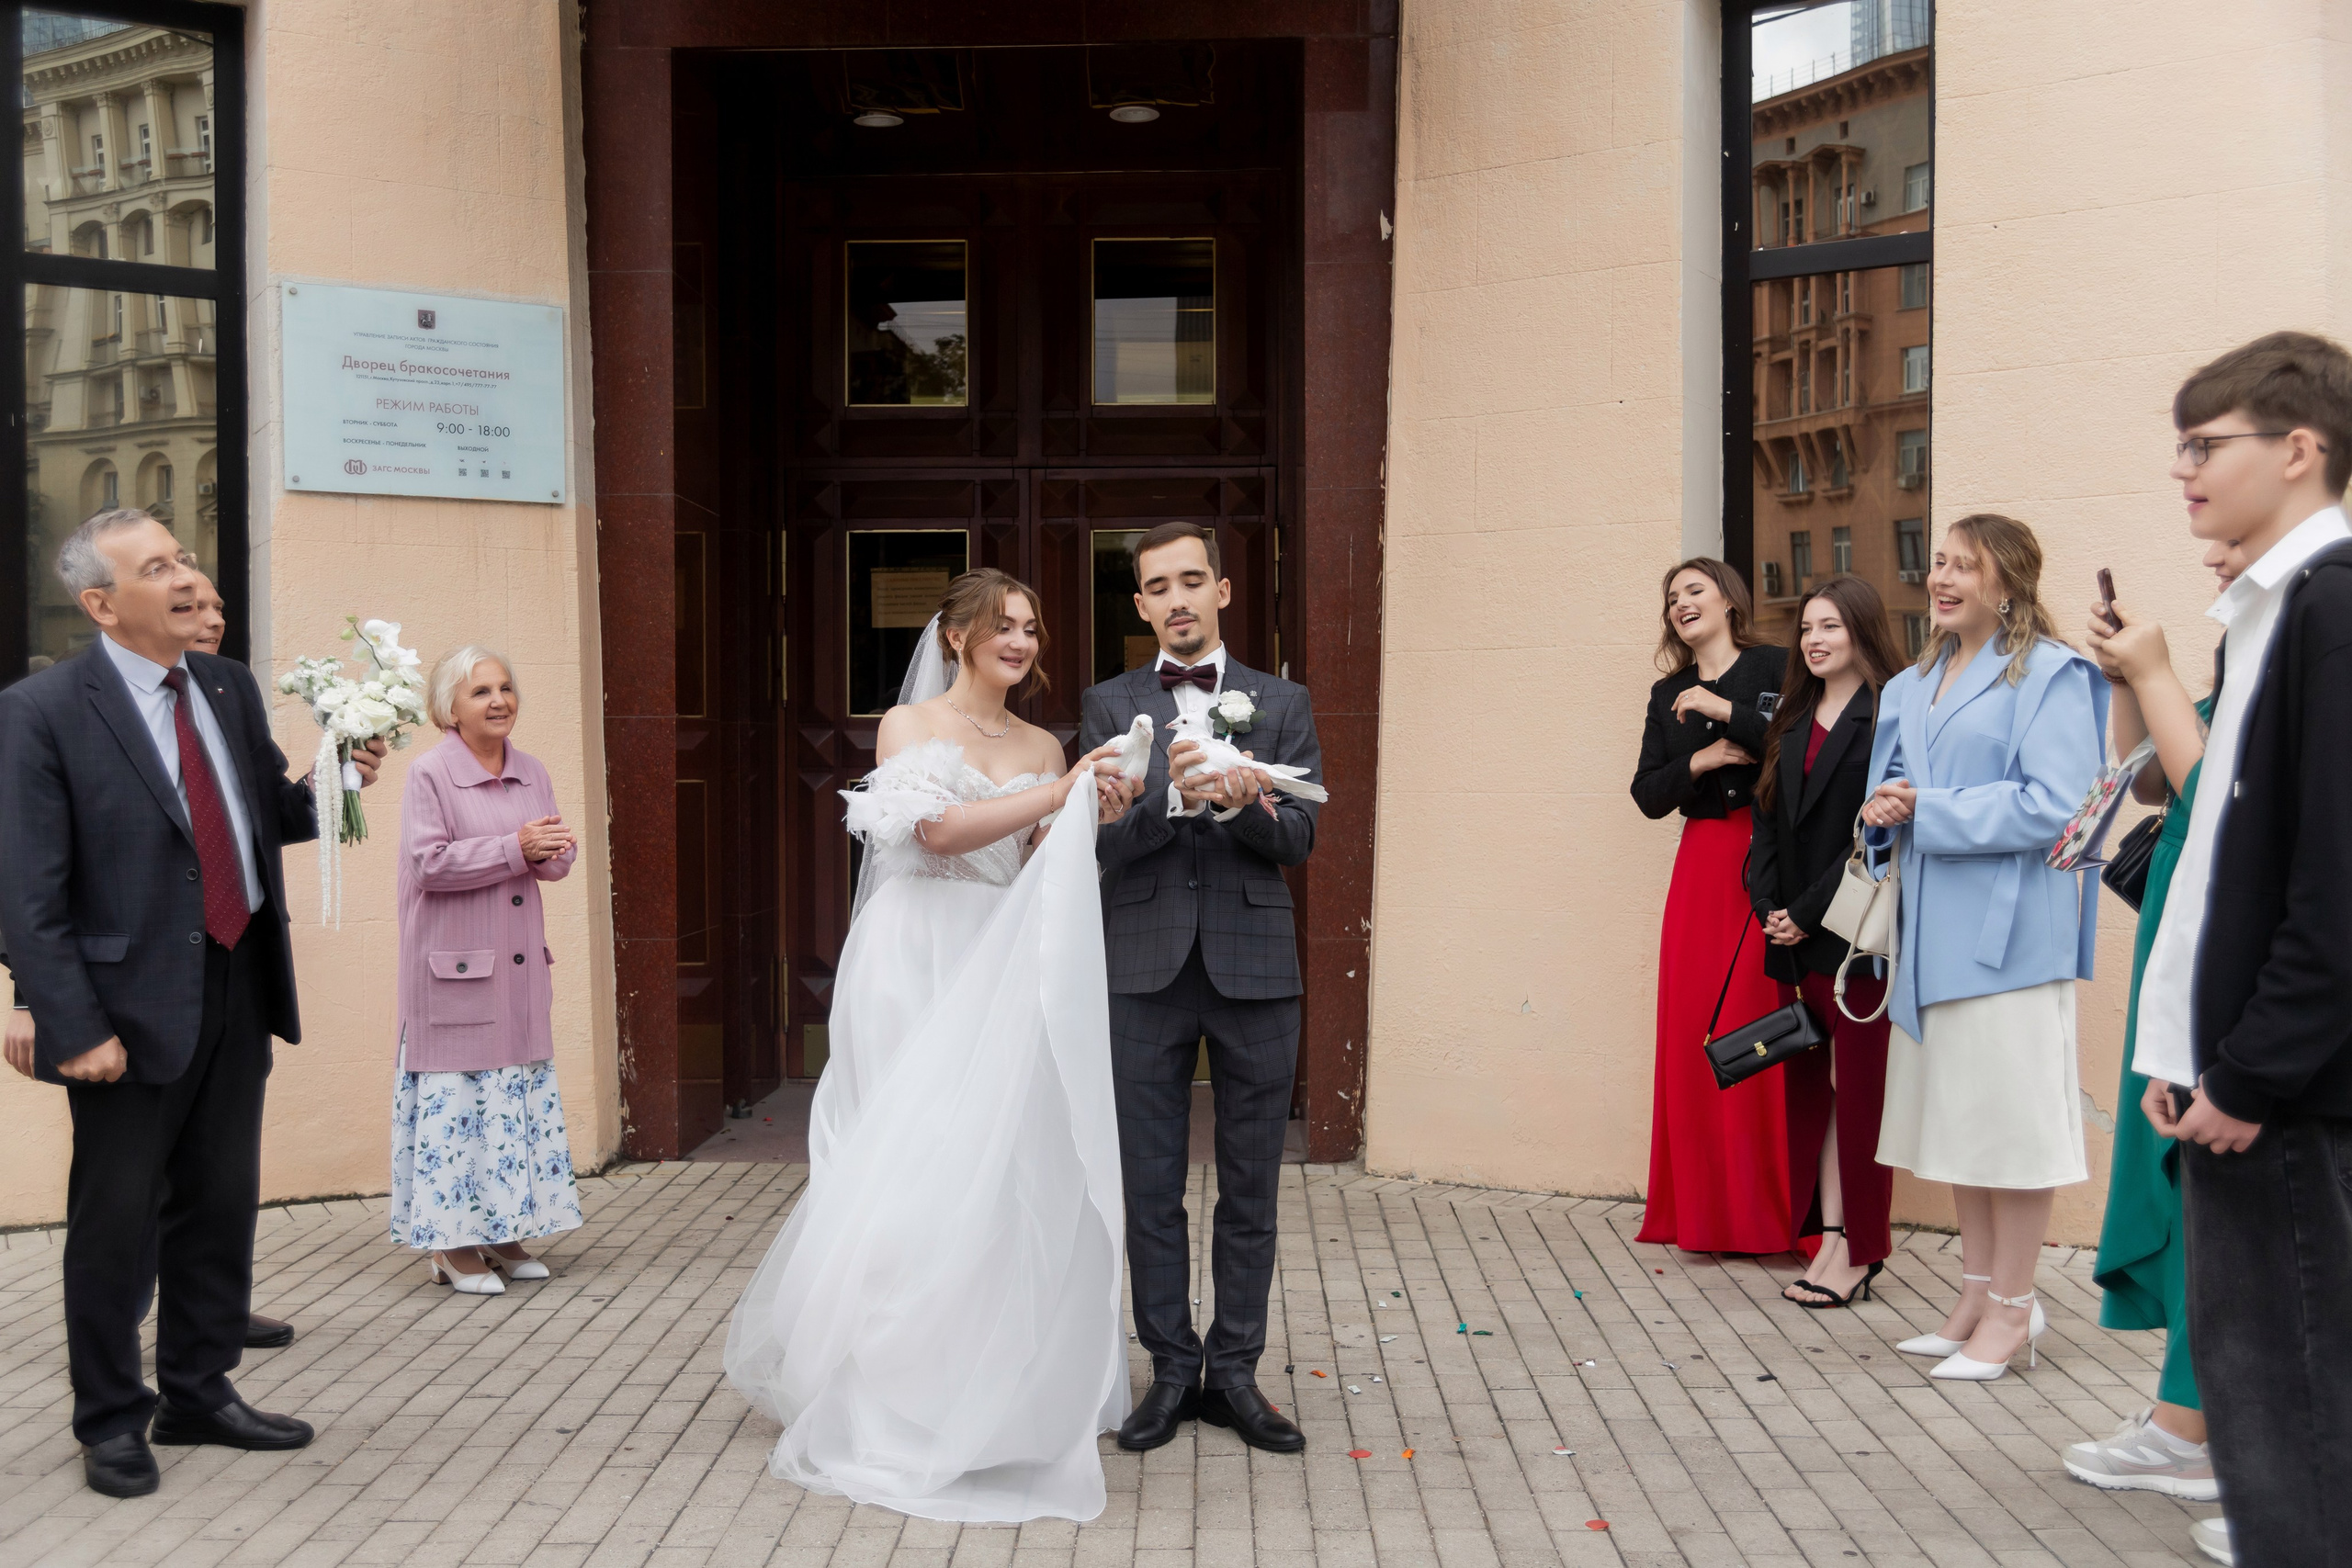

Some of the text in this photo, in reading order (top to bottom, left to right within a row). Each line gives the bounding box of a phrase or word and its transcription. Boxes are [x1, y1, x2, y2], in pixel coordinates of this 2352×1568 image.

[342, 355, 510, 380] Дворец бракосочетания
[376, 398, 479, 416] РЕЖИМ РАБОТЫ
[436, 422, 465, 434] 9:00
[478, 425, 511, 438] 18:00
